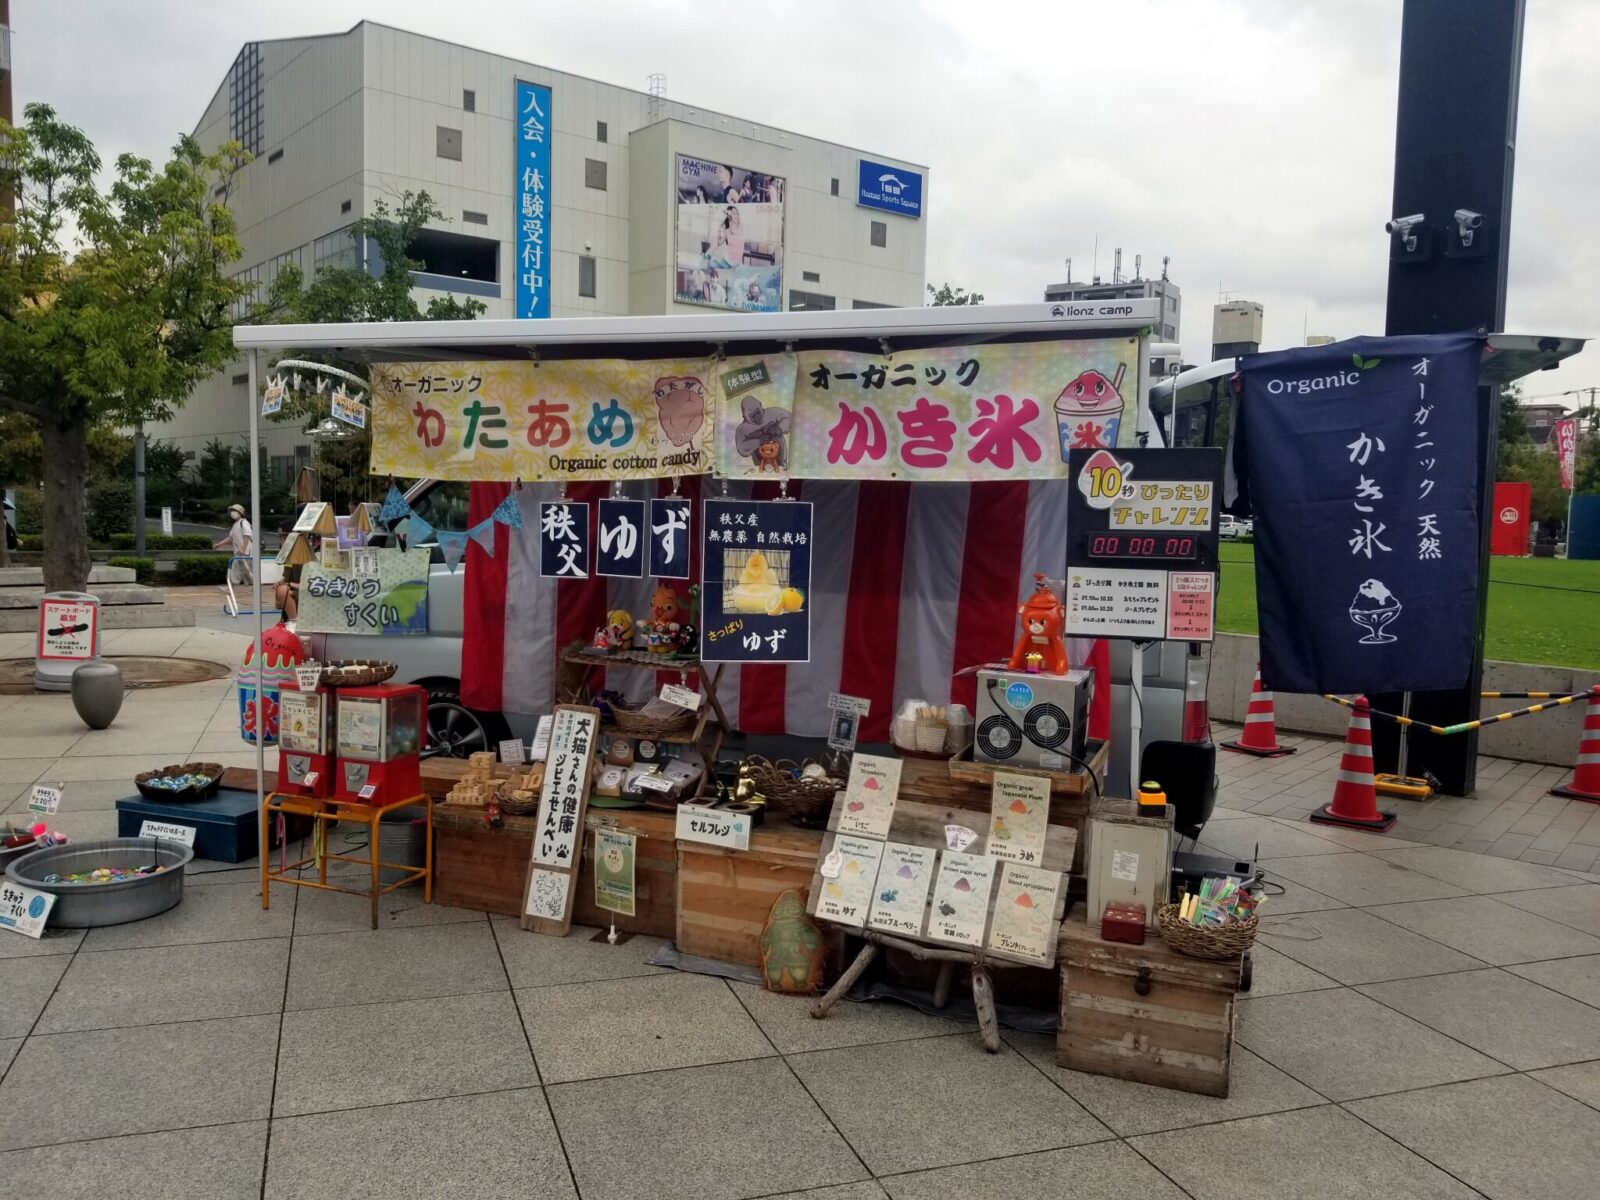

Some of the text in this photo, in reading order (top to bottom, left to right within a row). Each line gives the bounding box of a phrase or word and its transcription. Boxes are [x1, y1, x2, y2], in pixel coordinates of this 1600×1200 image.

[682, 158, 718, 174] MACHINE
[682, 166, 700, 177] GYM
[861, 188, 919, 209] Itoman Sports Square
[1067, 306, 1133, 317] lionz camp
[391, 375, 482, 394] オーガニック
[726, 368, 765, 391] 体験型
[808, 358, 981, 390] オーガニック
[1267, 370, 1361, 394] Organic
[413, 398, 634, 449] わたあめ
[826, 392, 1043, 471] かき氷
[549, 449, 700, 473] Organic cotton candy
[1411, 357, 1443, 560] オーガニック 天然
[1346, 432, 1393, 559] かき氷
[719, 512, 759, 527] 秩父産
[1113, 506, 1209, 526] チャレンジ
[541, 504, 588, 577] 秩父
[708, 529, 808, 545] 無農薬 自然栽培
[1093, 537, 1192, 555] 00 00 00
[307, 576, 381, 598] ちきゅう
[344, 602, 400, 627] すくい
[706, 618, 744, 642] さっぱり
[742, 628, 788, 654] ゆず
[558, 718, 592, 834] 犬猫さんの健康
[996, 781, 1018, 789] Organic
[541, 753, 568, 858] ジビエせんべい
[1002, 790, 1028, 799] Japanese
[690, 819, 731, 837] セルフレジ
[1019, 849, 1035, 862] うめ
